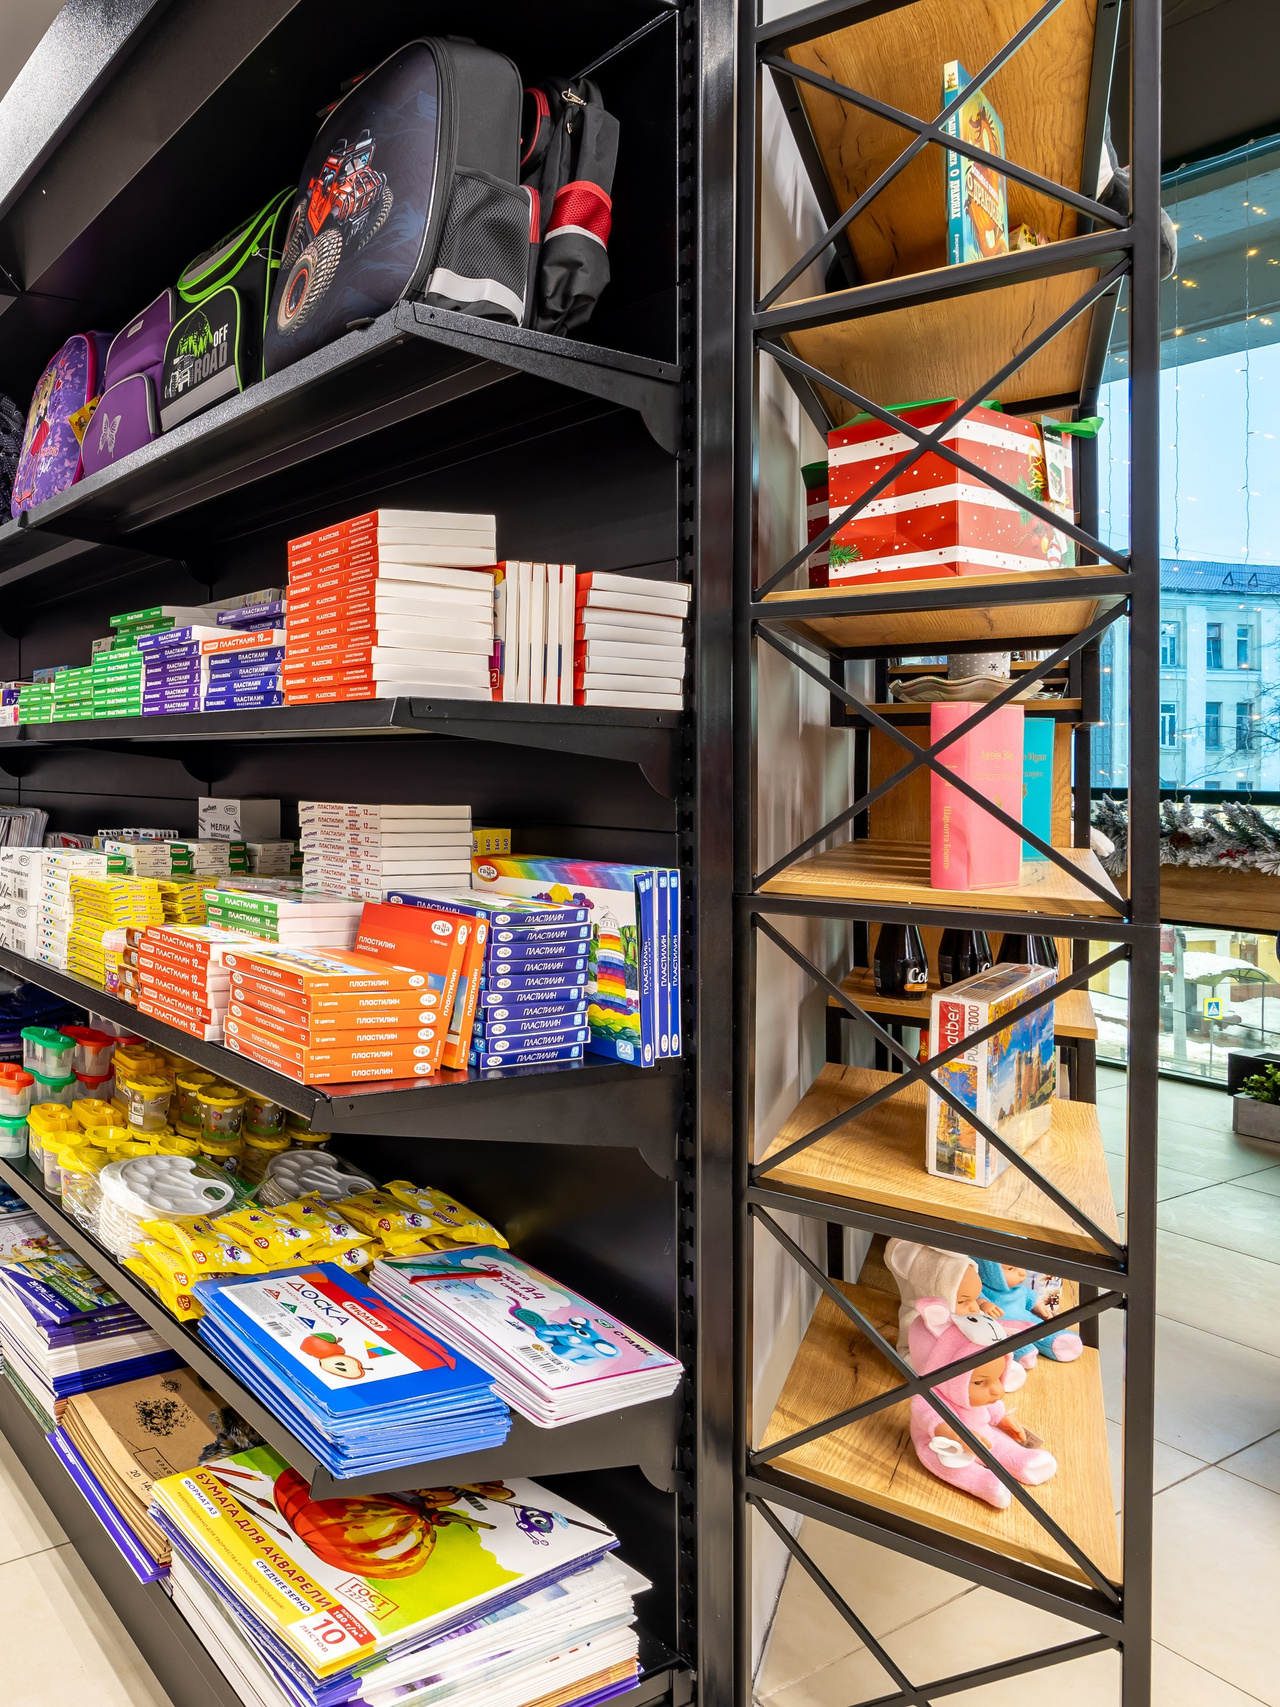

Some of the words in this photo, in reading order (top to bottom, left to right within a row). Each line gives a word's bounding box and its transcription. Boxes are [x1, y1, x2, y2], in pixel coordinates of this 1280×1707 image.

[950, 168, 959, 177] О
[967, 173, 973, 191] О
[213, 323, 229, 347] OFF
[194, 342, 227, 384] ROAD
[220, 637, 255, 648] ПЛАСТИЛИН
[257, 634, 263, 642] 12
[238, 652, 268, 660] ПЛАСТИЛИН
[210, 823, 230, 831] МЕЛКИ
[942, 805, 952, 842] Шарлотта
[322, 855, 348, 864] ПЛАСТИЛИН
[943, 844, 952, 870] Бронте
[321, 882, 347, 890] ПЛАСТИЛИН
[225, 898, 259, 910] ПЛАСТИЛИН
[228, 911, 261, 924] ПЛАСТИЛИН
[525, 914, 564, 922] ПЛАСТИЛИН
[162, 934, 194, 950] ПЛАСТИЛИН
[196, 941, 202, 952] 12
[356, 944, 379, 953] plasticine
[526, 946, 565, 955] ПЛАСТИЛИН
[156, 978, 190, 997] ПЛАСТИЛИН
[192, 991, 199, 1001] 12
[517, 992, 557, 1001] ПЛАСТИЛИН
[154, 1008, 188, 1027] ПЛАСТИЛИН
[190, 1022, 196, 1032] 12
[521, 1019, 561, 1030] ПЛАСТИЛИН
[476, 1040, 484, 1048] 12
[619, 1043, 631, 1054] 24
[517, 1051, 558, 1062] ПЛАСТИЛИН
[260, 1239, 268, 1247] 20
[197, 1252, 205, 1262] 20
[179, 1274, 188, 1285] 20
[500, 1282, 530, 1300] стека
[182, 1298, 190, 1308] 20
[286, 1281, 349, 1326] ДОСКА
[345, 1303, 384, 1329] ПИФАГОР
[130, 1470, 141, 1478] 20
[184, 1479, 210, 1508] ФОРМАТ
[207, 1506, 217, 1516] А3
[195, 1472, 239, 1518] БУМАГА
[234, 1515, 265, 1545] ДЛЯ
[260, 1545, 333, 1609] АКВАРЕЛИ
[213, 1535, 238, 1563] ТВОРЧЕСТВА
[240, 1566, 258, 1584] УРОКОВ
[256, 1561, 288, 1592] СРЕДНЕЕ
[284, 1589, 311, 1613] ЗЕРНО
[343, 1588, 380, 1613] 7277-77
[350, 1582, 390, 1608] ГОСТ
[333, 1611, 348, 1624] 180
[341, 1608, 369, 1636] ПЛОТНОСТЬ
[321, 1618, 347, 1645] 10
[300, 1625, 328, 1653] ЛИСТОВ
